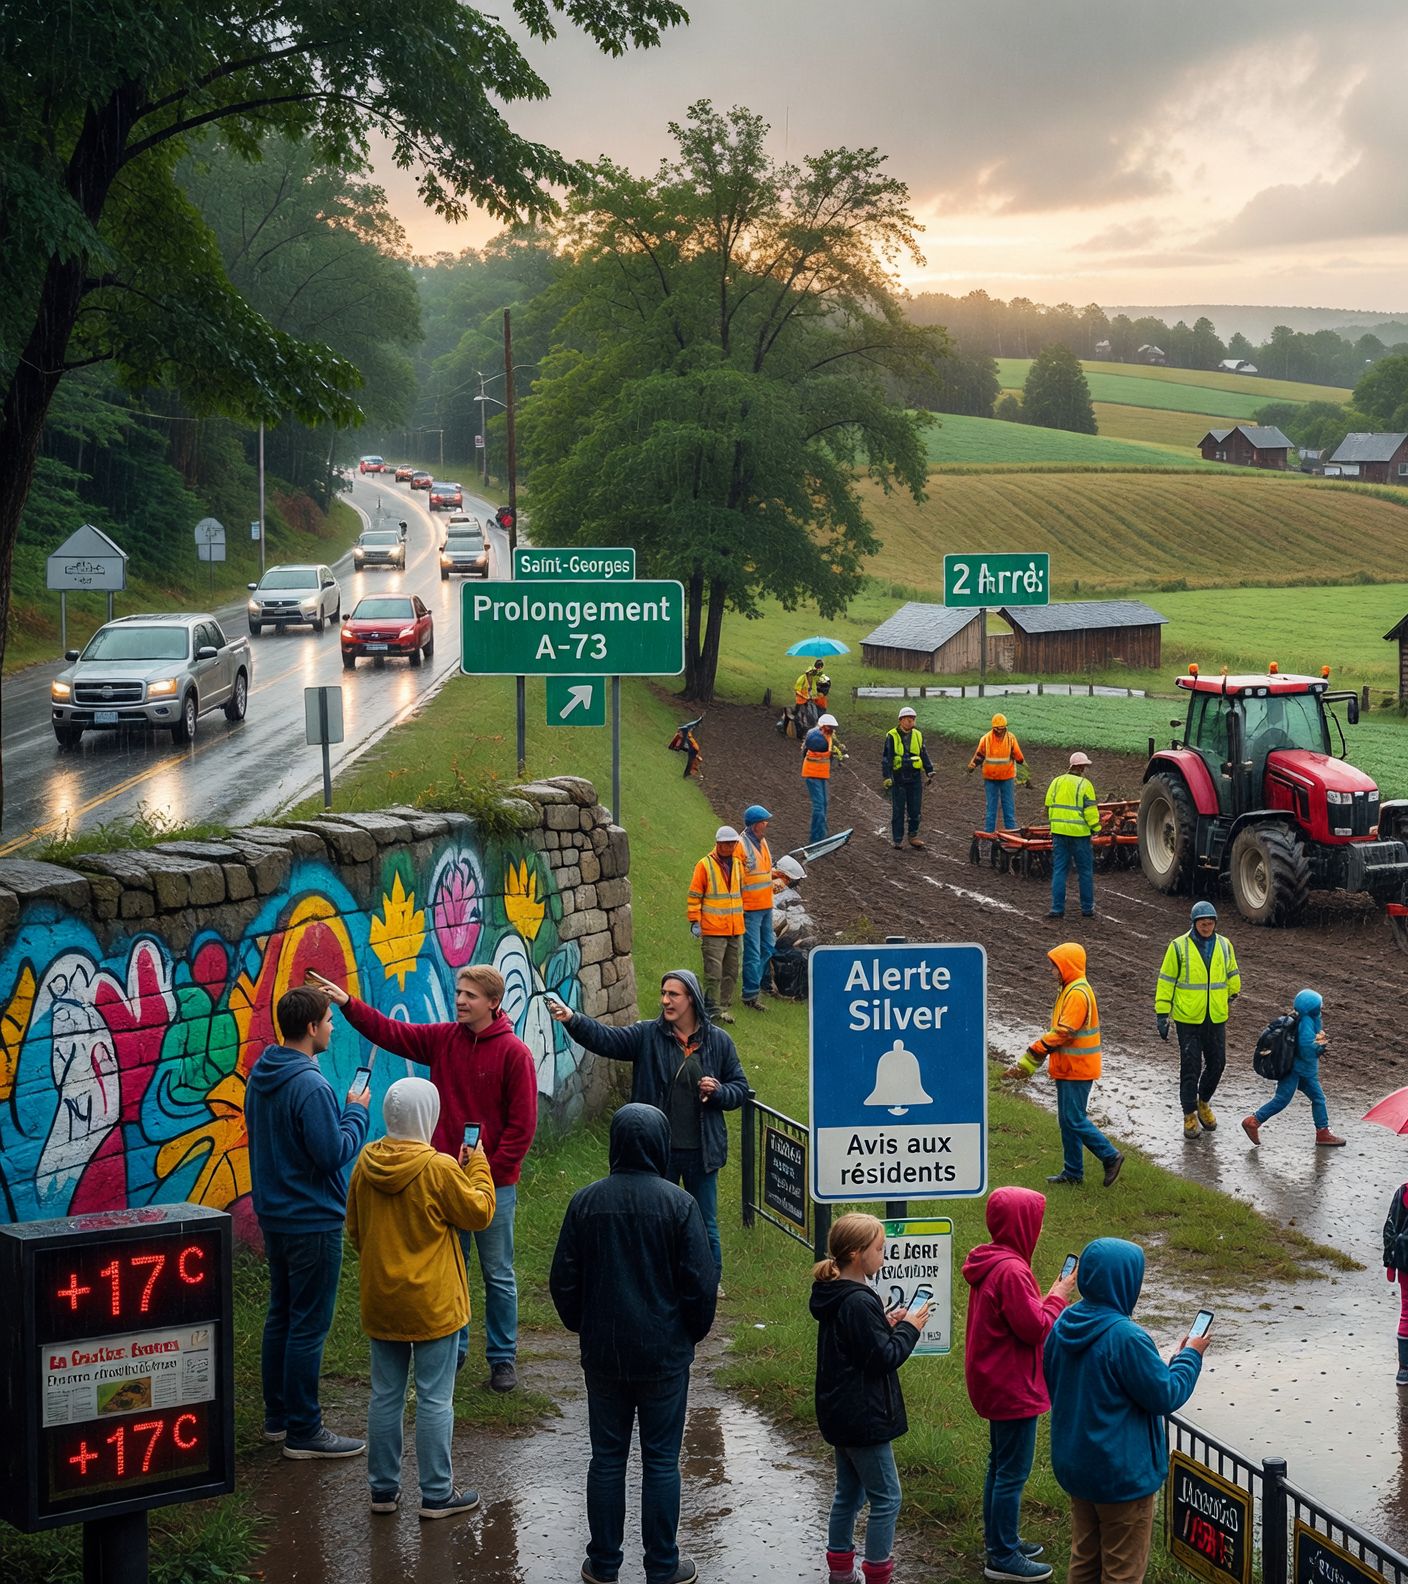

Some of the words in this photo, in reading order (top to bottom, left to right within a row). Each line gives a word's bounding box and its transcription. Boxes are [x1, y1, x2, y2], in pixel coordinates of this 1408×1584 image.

[520, 555, 630, 579] Saint-Georges
[952, 563, 971, 595] 2
[473, 595, 671, 629] Prolongement
[535, 633, 608, 660] A-73
[843, 958, 951, 992] Alerte
[848, 998, 948, 1032] Silver
[846, 1131, 898, 1156] Avis
[907, 1135, 952, 1154] aux
[840, 1160, 956, 1185] résidents
